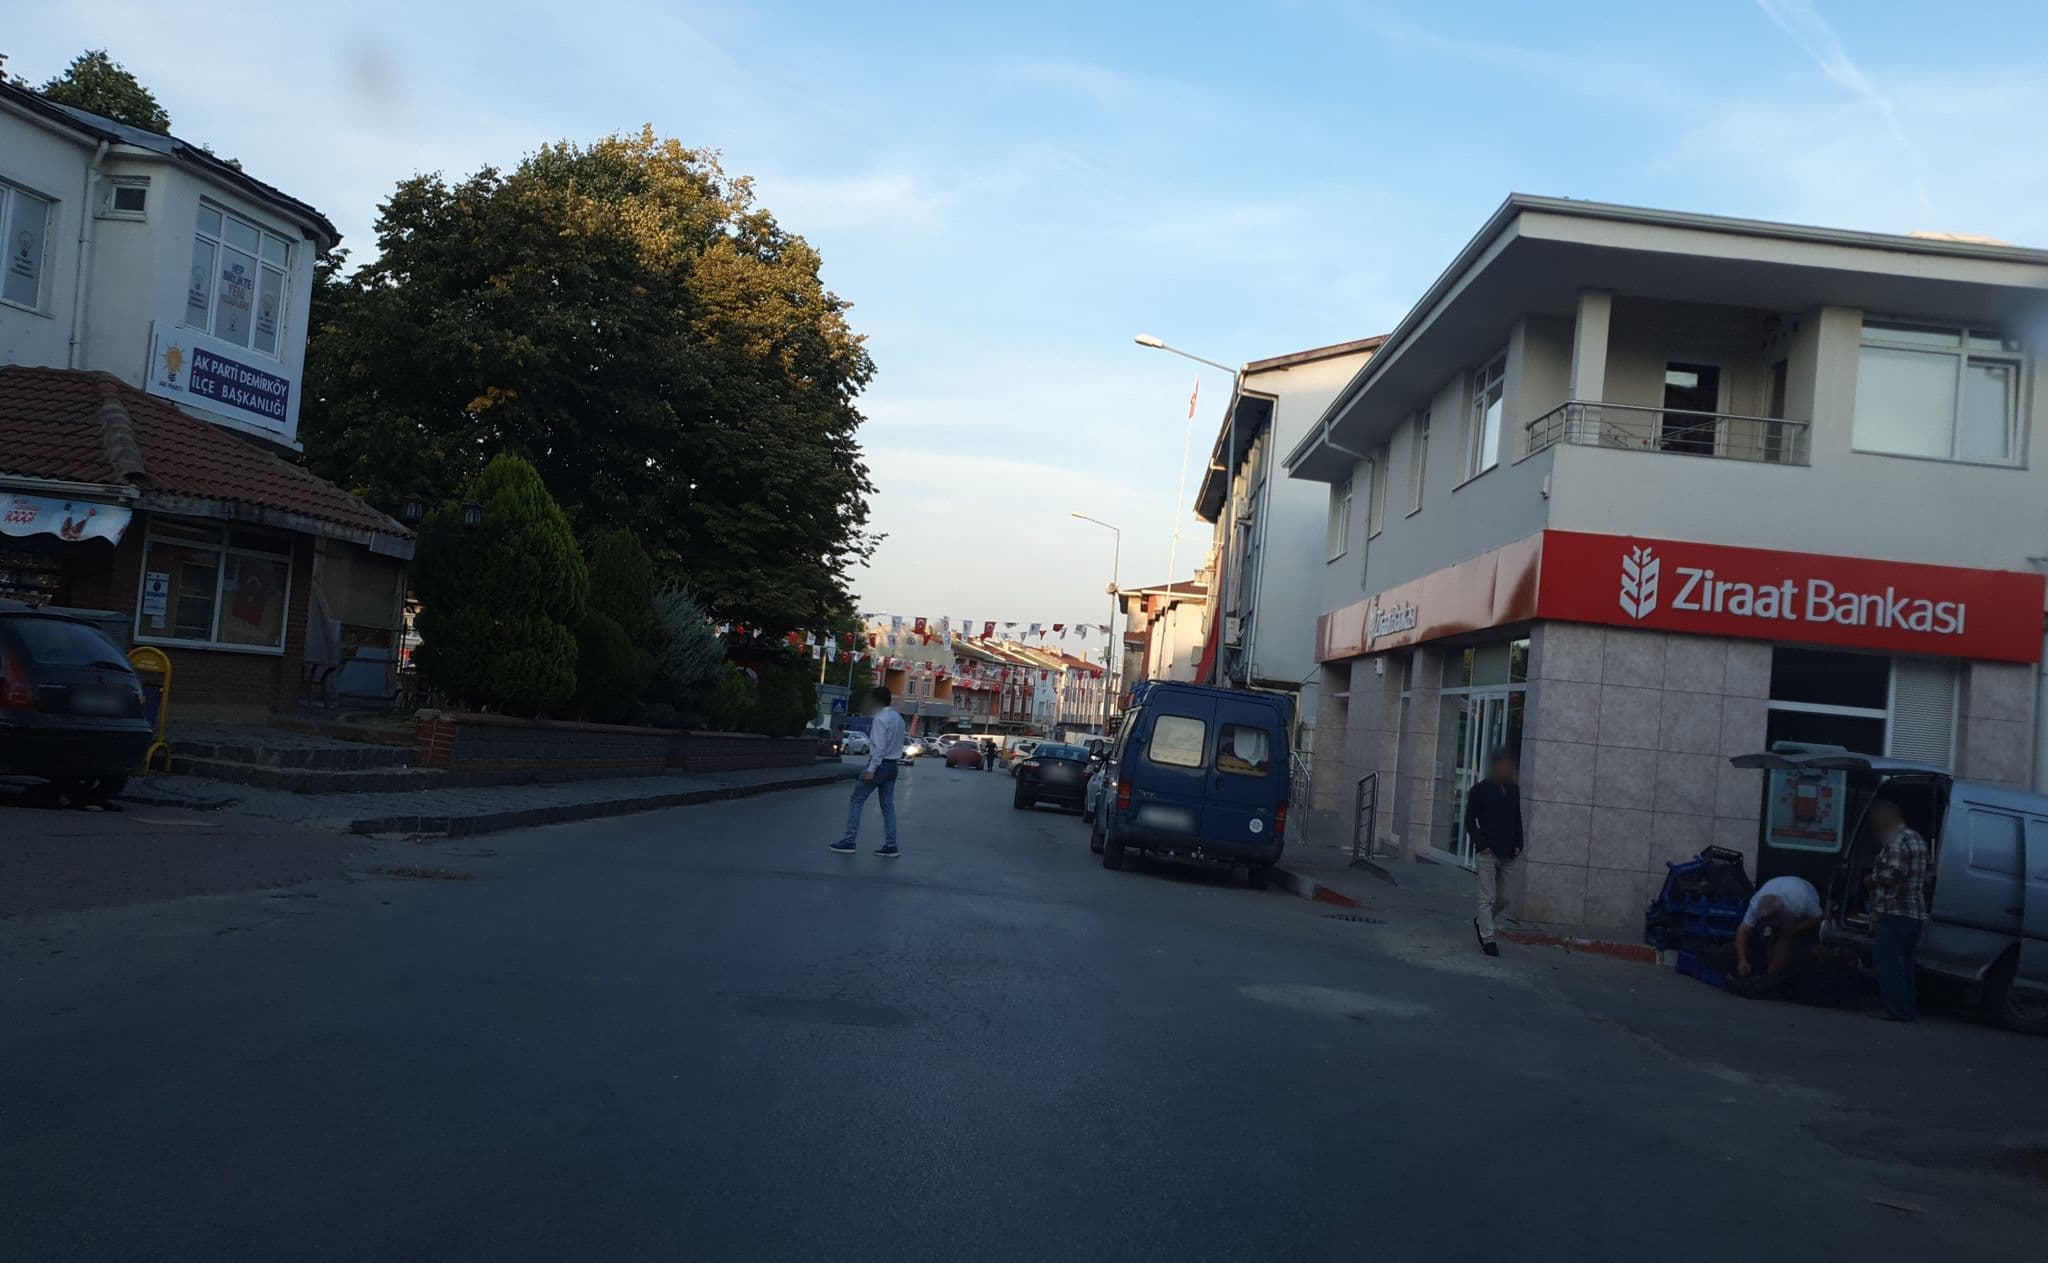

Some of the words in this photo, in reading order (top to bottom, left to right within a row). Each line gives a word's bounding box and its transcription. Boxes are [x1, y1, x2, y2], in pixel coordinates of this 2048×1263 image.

[191, 370, 215, 396] İLÇE
[221, 384, 285, 417] BAŞKANLIĞI
[193, 354, 210, 372] AK
[210, 361, 239, 381] PARTİ
[239, 371, 287, 397] DEMİRKÖY
[1671, 567, 1799, 621] Ziraat
[1804, 578, 1966, 635] Bankası
